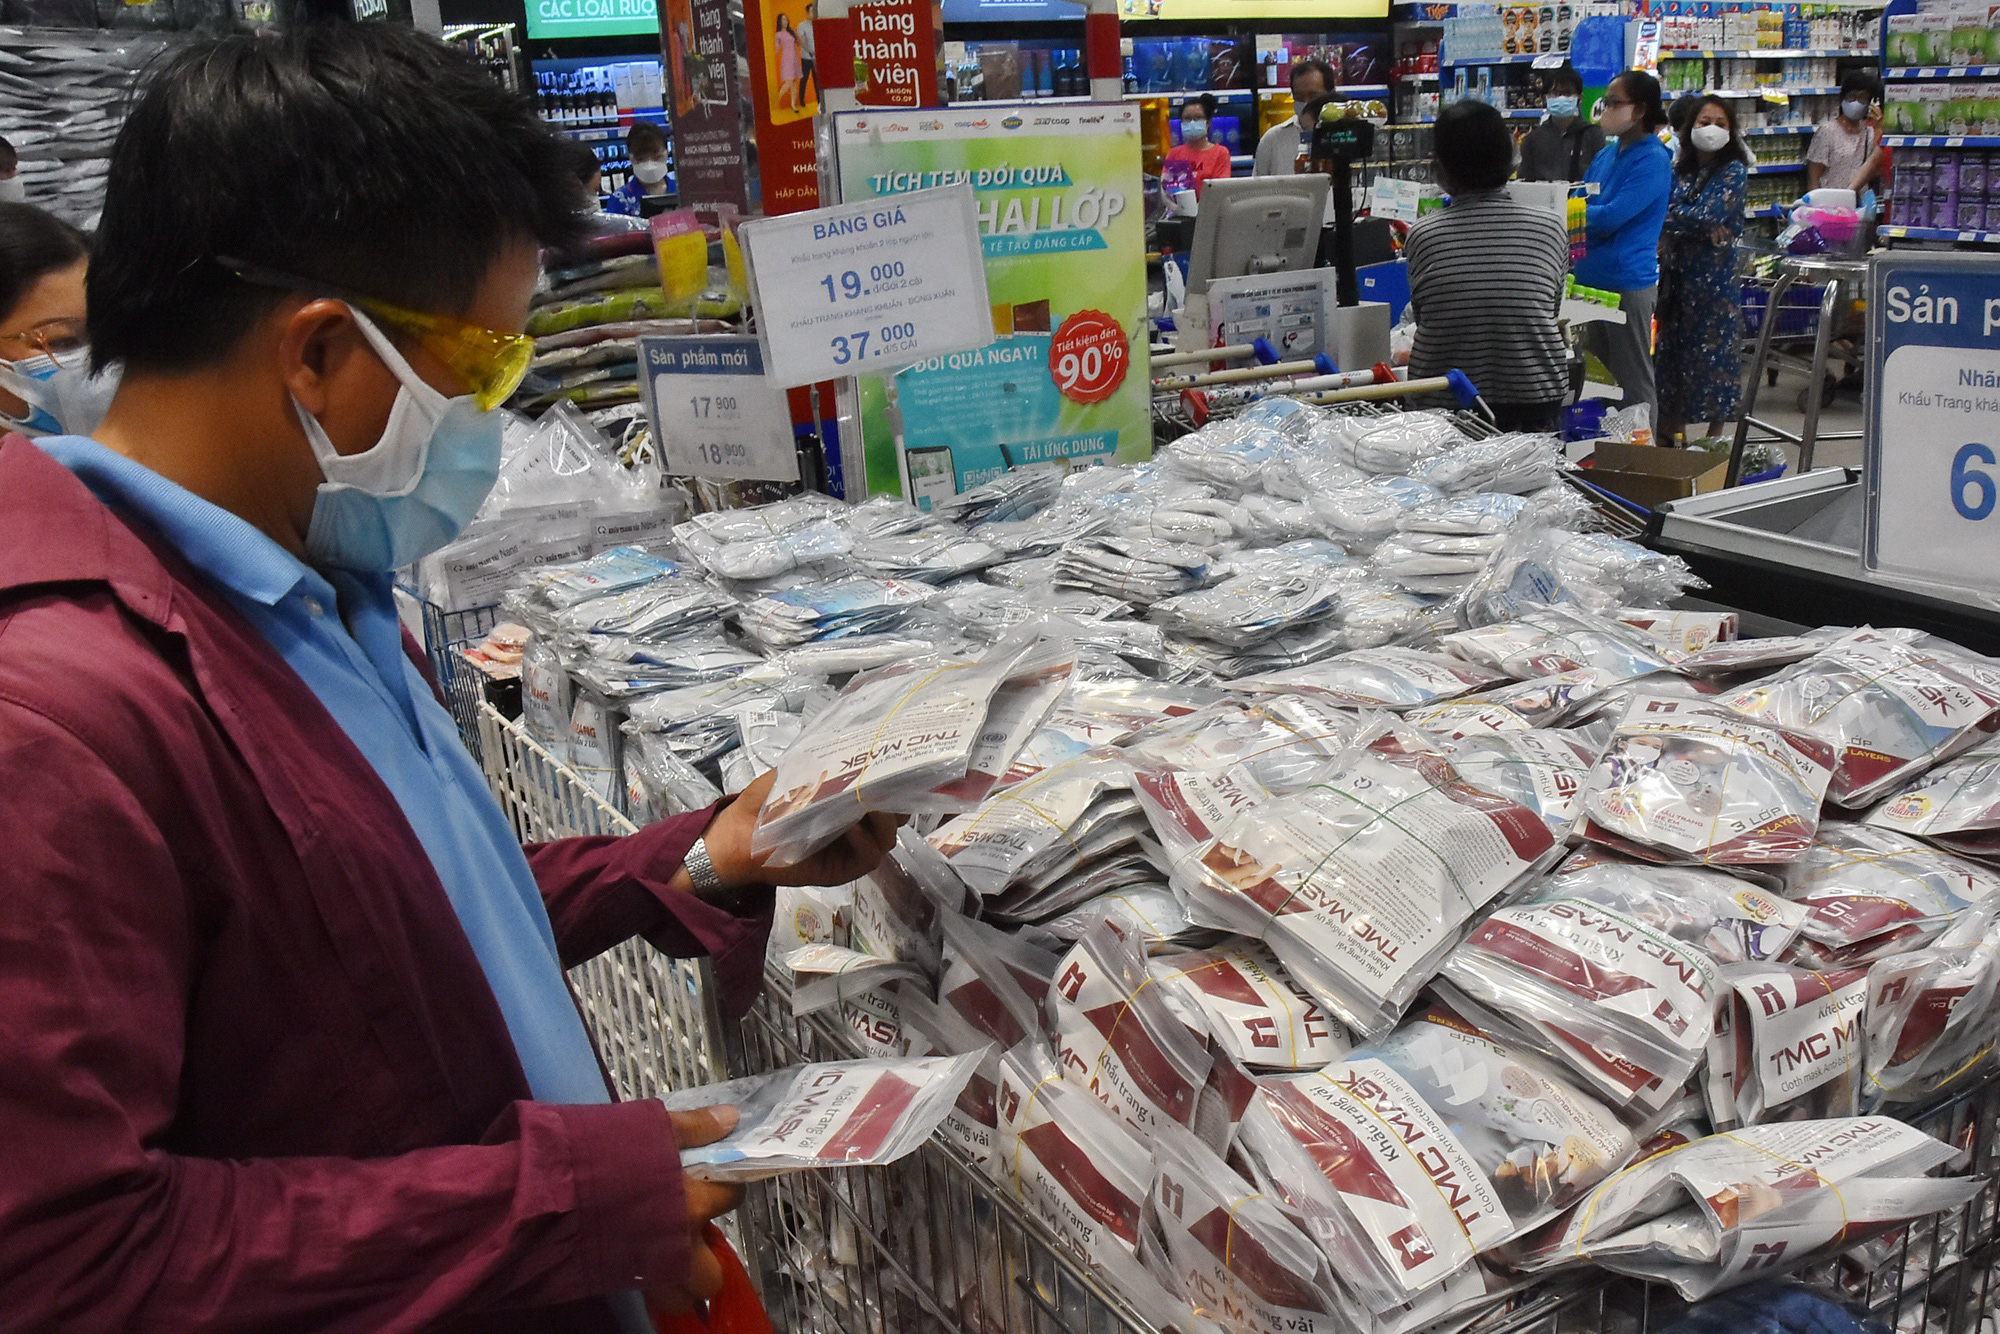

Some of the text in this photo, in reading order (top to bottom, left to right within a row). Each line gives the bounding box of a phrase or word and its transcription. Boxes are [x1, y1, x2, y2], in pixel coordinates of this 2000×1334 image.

[860, 11, 915, 35] hàng
[1426, 4, 1449, 20] Tiger
[700, 33, 723, 55] thành
[853, 38, 917, 60] thành
[708, 61, 726, 79] viên
[873, 64, 917, 84] viên
[873, 162, 1063, 192] TÍCH TEM ĐỔI QUÀ
[1051, 186, 1125, 231] LỚP
[813, 205, 906, 240] BẢNG GIÁ
[900, 278, 907, 287] 2
[1886, 284, 1958, 325] Sản
[1056, 327, 1117, 353] Tiết kiệm đến
[650, 345, 748, 368] Sản phẩm mới
[949, 346, 1038, 370] QUÀ NGAY!
[1058, 340, 1123, 390] 90%
[690, 396, 711, 418] 17
[1898, 391, 1972, 412] Khẩu Trang
[699, 443, 722, 465] 18
[1950, 442, 1997, 521] 6
[1954, 691, 1975, 708] vải
[841, 729, 961, 772] TMC MASK
[1850, 749, 1892, 763] LAYERS
[1795, 758, 1815, 774] vải
[1730, 806, 1781, 833] 3 LỚP
[996, 834, 1028, 851] TMC
[1314, 912, 1329, 923] UV
[1510, 907, 1534, 924] vải
[1352, 920, 1400, 963] TMC
[1345, 945, 1368, 965] trang
[1636, 937, 1708, 1003] TMC
[1692, 955, 1715, 981] Cloth
[1770, 1031, 1831, 1077] TMC
[1098, 1053, 1121, 1085] Khẩu
[1118, 1080, 1149, 1116] trang
[1368, 1067, 1409, 1098] anti-UV
[1780, 1068, 1823, 1093] Cloth mask
[1311, 1084, 1334, 1103] vải
[1337, 1097, 1369, 1134] trang
[1572, 1115, 1596, 1139] TRANG
[972, 1130, 990, 1147] vải
[1367, 1127, 1401, 1163] Khẩu
[1832, 1119, 1883, 1150] TMC
[1336, 1068, 1482, 1237] TMC MASK
[1461, 1160, 1484, 1187] mask
[1036, 1171, 1060, 1207] Khẩu
[1062, 1202, 1093, 1243] trang
[1477, 1186, 1496, 1214] Cloth
[1286, 1317, 1314, 1334] vải
